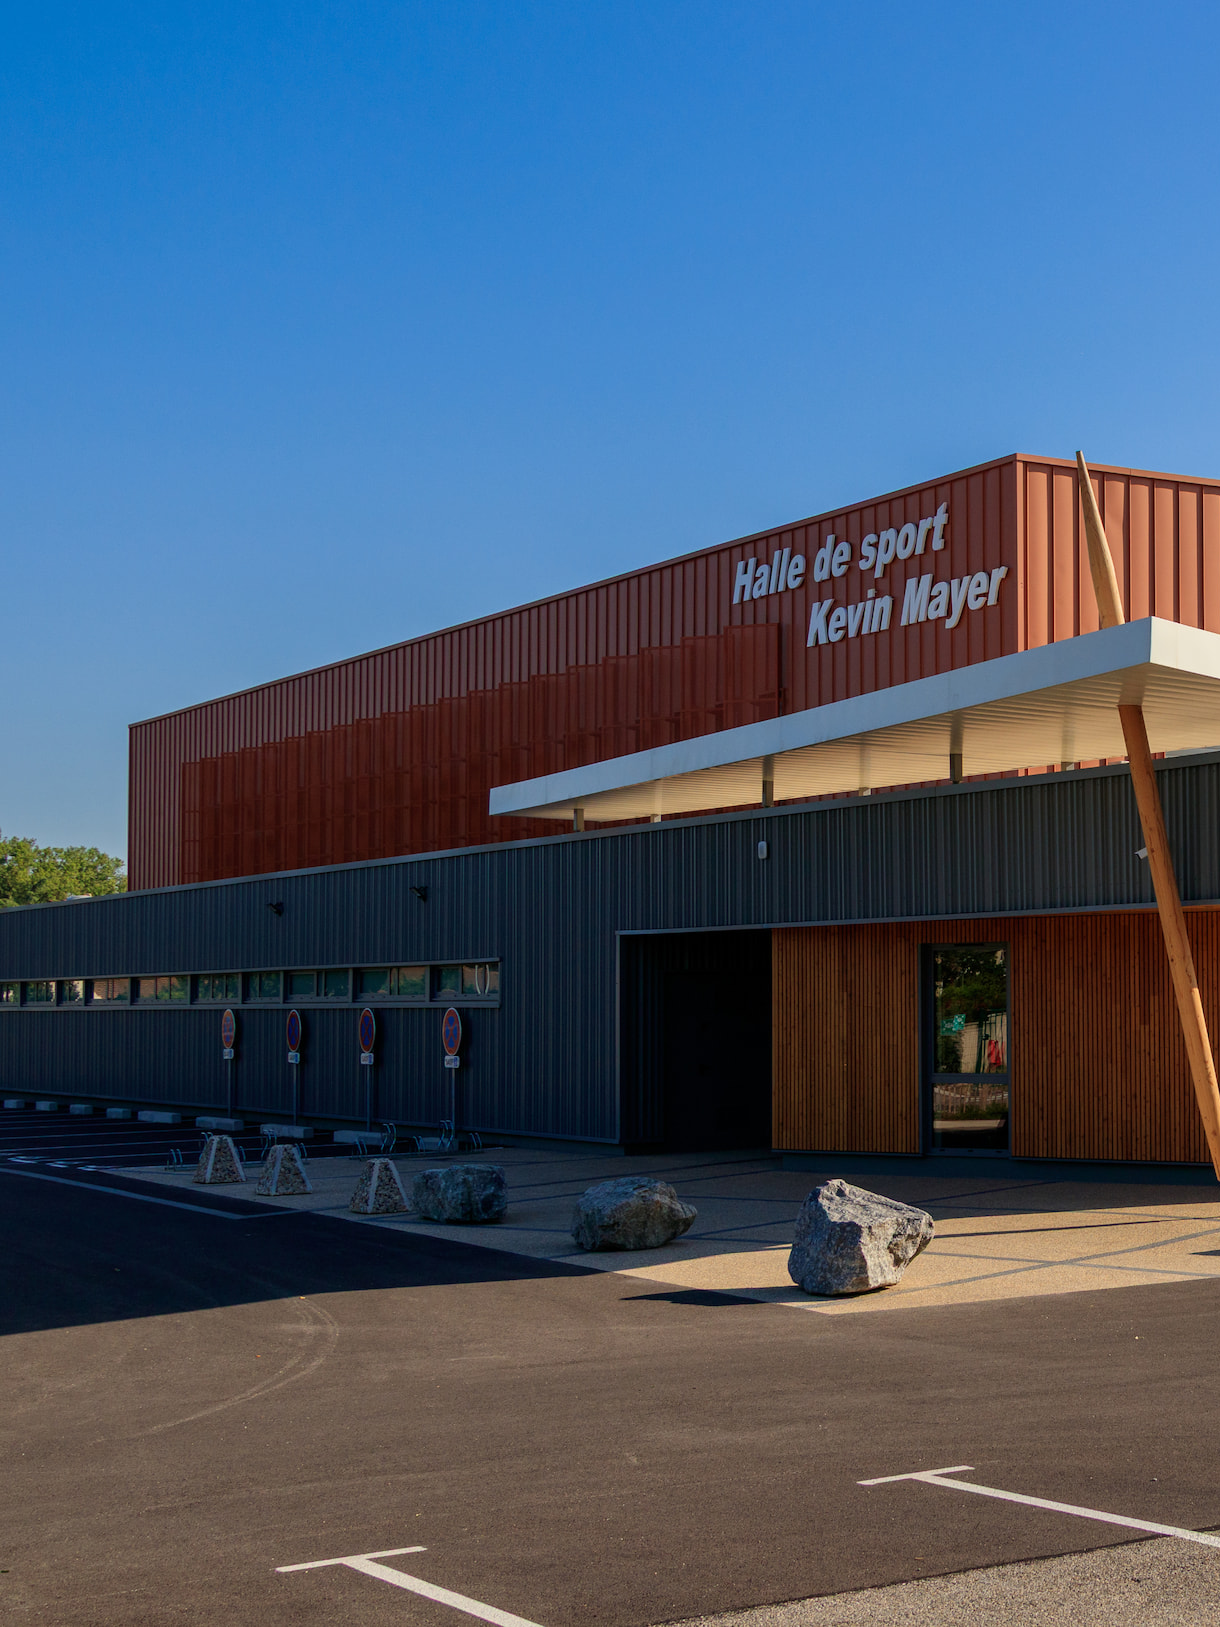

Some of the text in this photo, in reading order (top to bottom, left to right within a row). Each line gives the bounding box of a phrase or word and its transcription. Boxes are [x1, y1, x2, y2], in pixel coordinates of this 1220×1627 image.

[732, 502, 949, 605] Halle de sport
[806, 565, 1009, 648] Kevin Mayer
